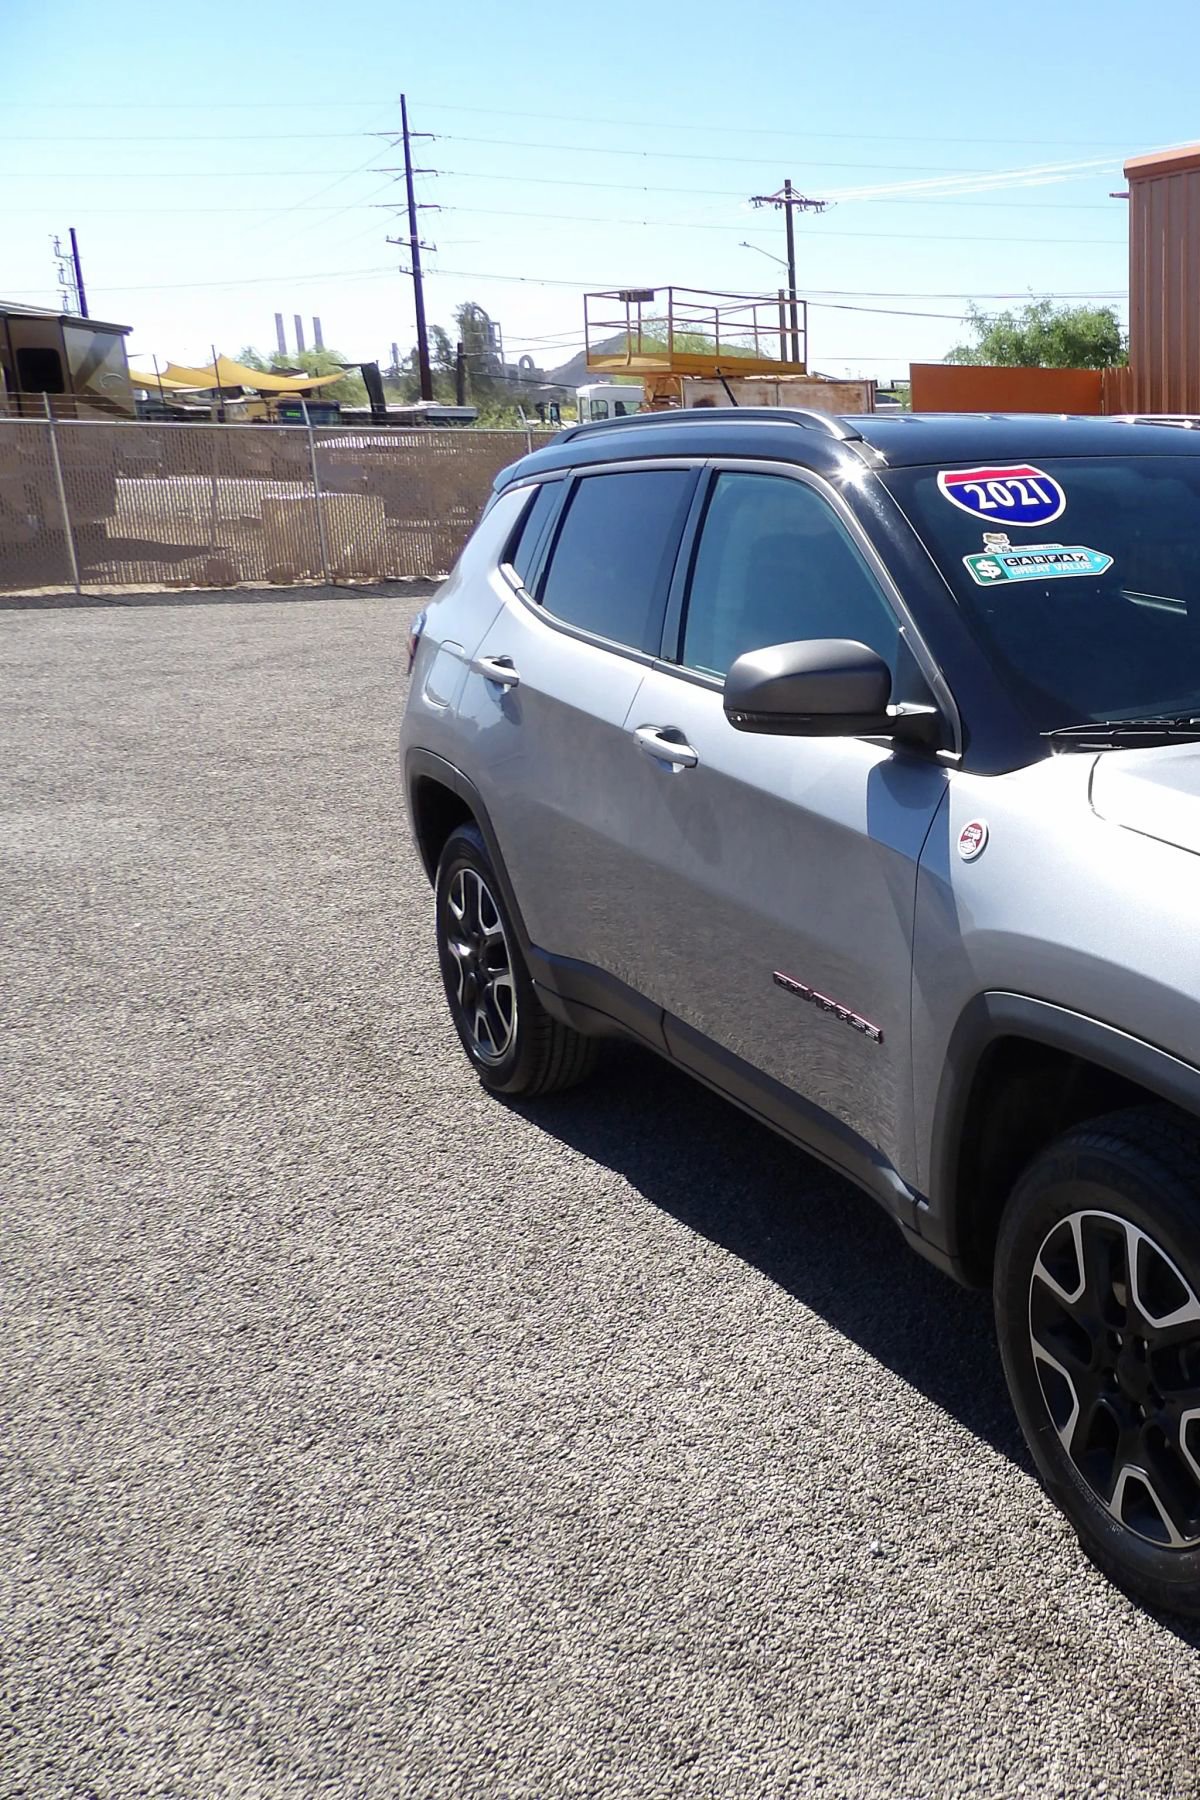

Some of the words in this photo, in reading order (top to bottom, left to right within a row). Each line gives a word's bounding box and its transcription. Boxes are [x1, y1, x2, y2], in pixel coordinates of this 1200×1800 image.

[964, 478, 1052, 510] 2021
[1004, 553, 1089, 566] CARFAX
[1011, 564, 1050, 576] GREAT
[1057, 562, 1093, 572] VALUE
